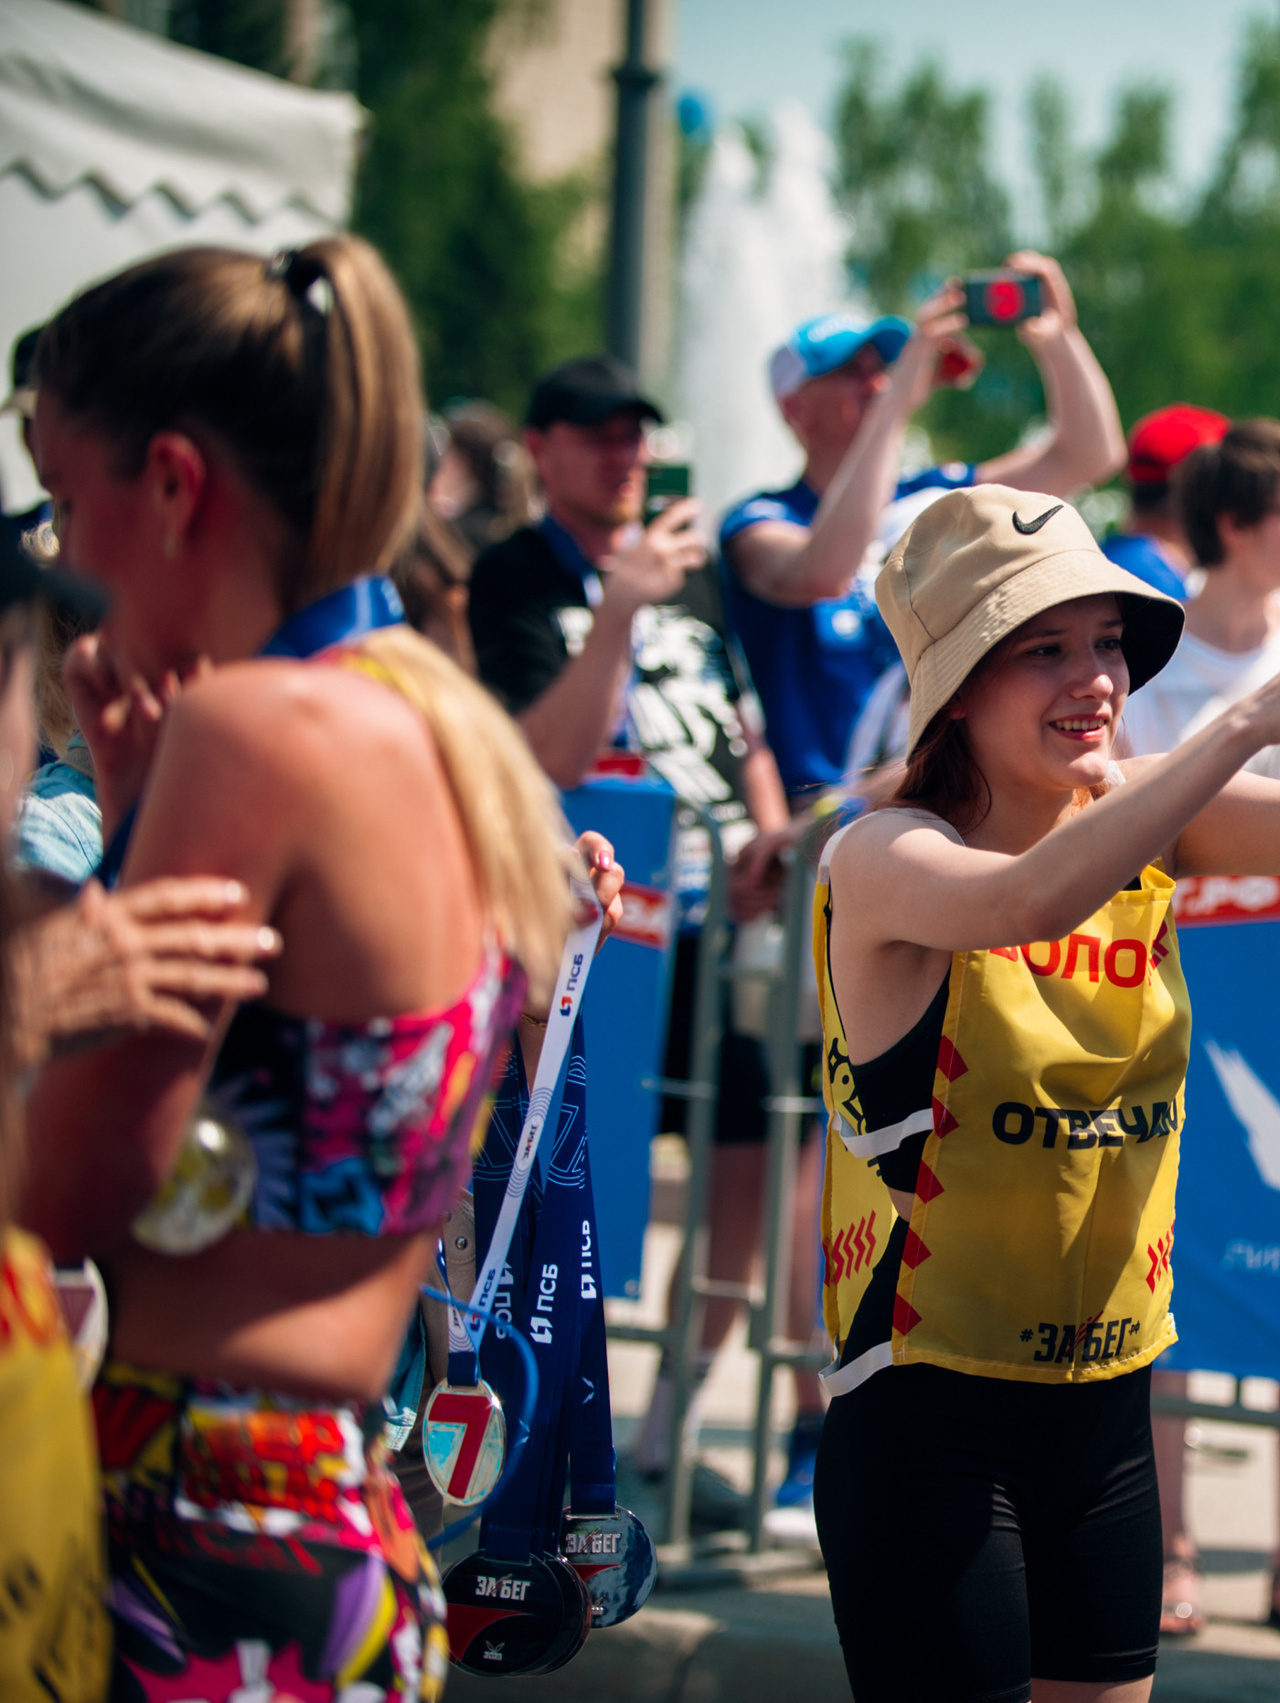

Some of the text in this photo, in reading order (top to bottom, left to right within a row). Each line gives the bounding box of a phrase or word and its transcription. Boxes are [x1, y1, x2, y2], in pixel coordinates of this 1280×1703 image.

[566, 953, 584, 992] ПСБ
[536, 1263, 559, 1312] ПСБ
[428, 1392, 495, 1500] 7
